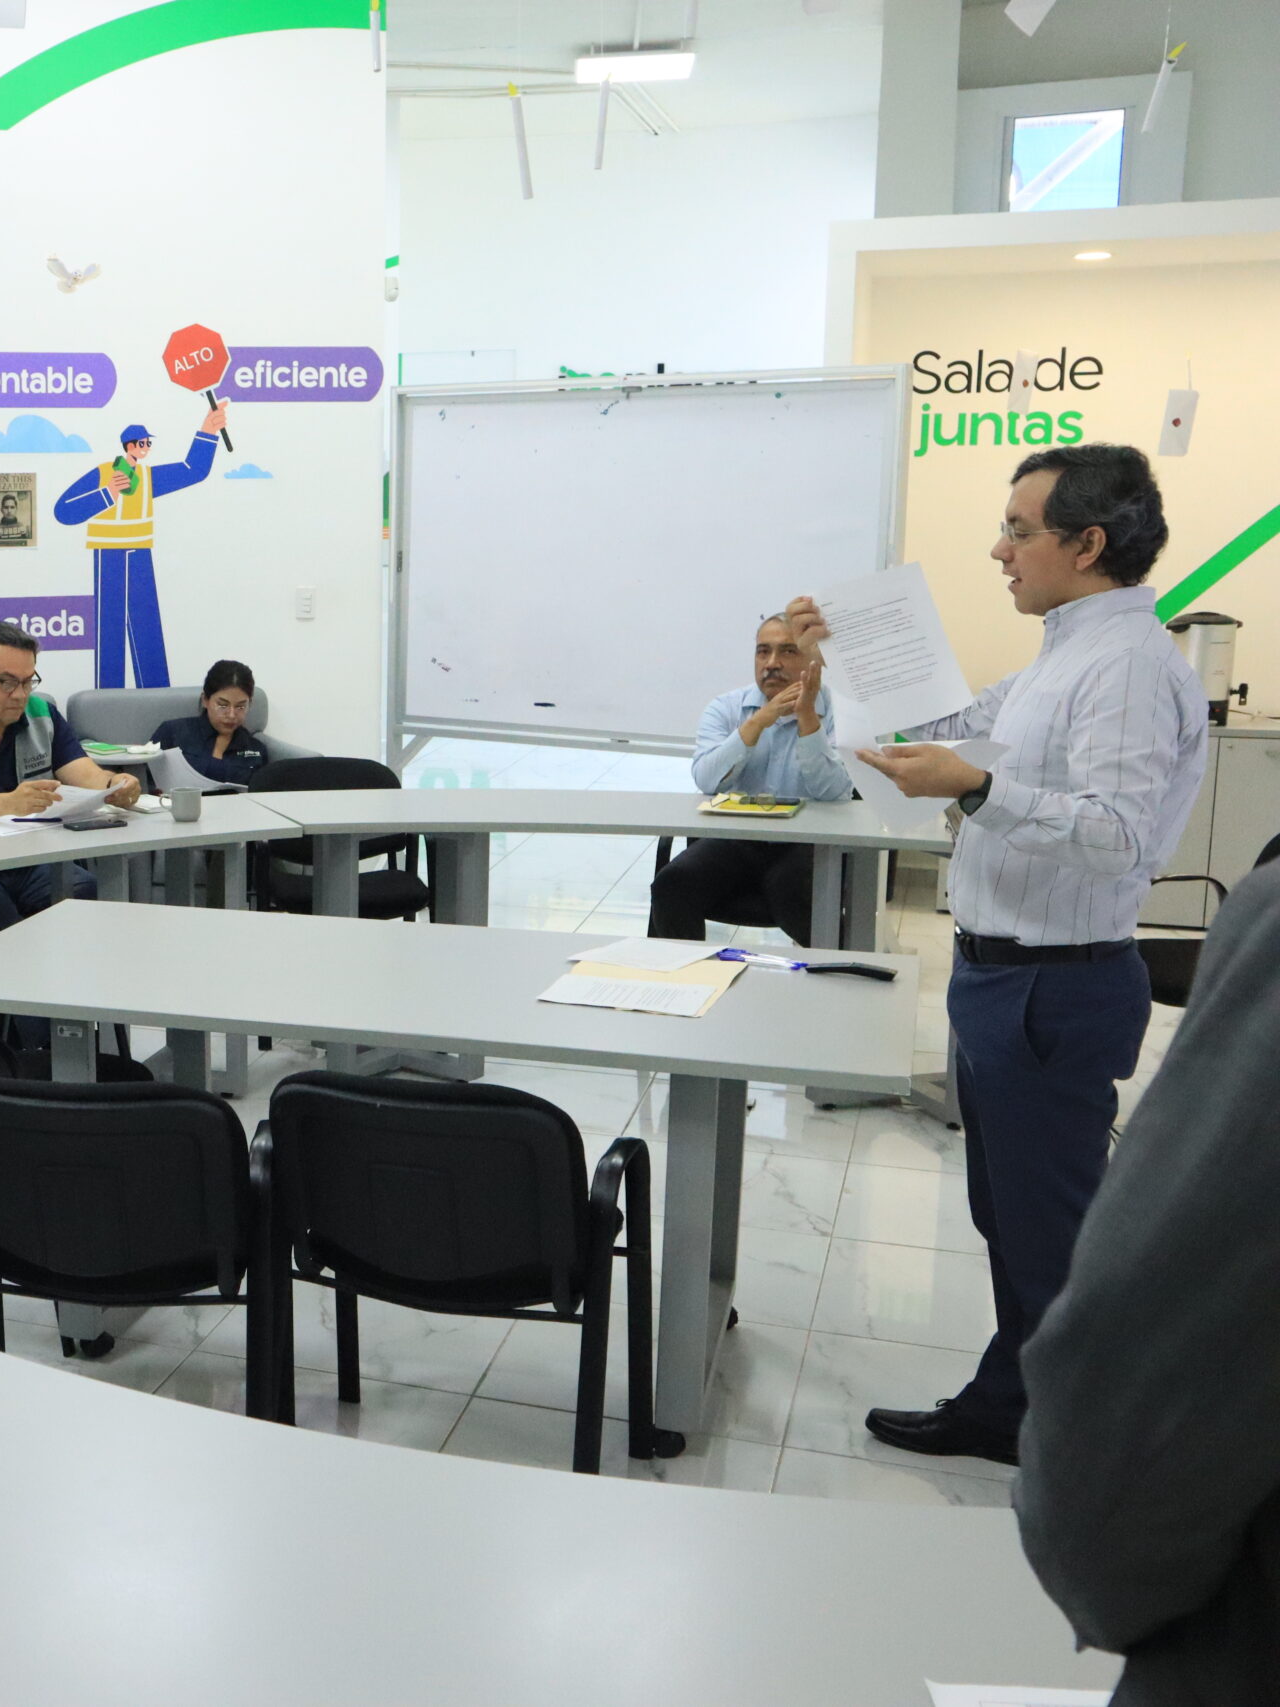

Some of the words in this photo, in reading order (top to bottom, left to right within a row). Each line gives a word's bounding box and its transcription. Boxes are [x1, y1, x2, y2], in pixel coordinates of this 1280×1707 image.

[174, 346, 214, 374] ALTO
[234, 359, 368, 388] eficiente
[913, 349, 1014, 395] Sala
[1033, 346, 1104, 393] de
[913, 402, 1084, 457] juntas
